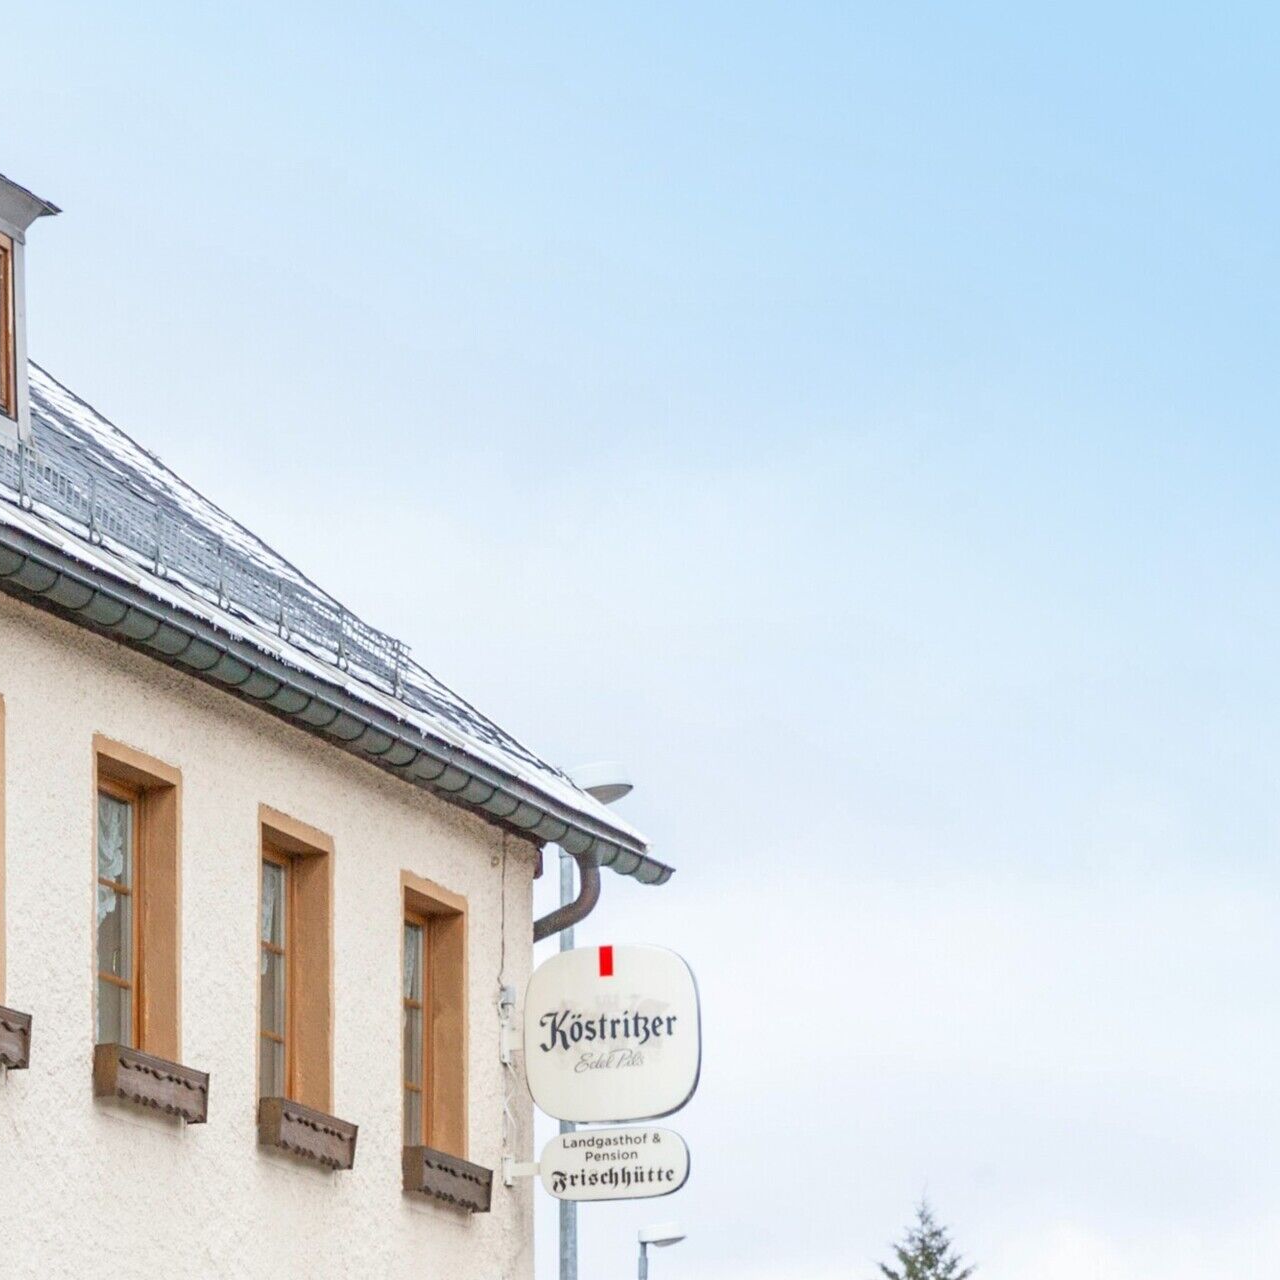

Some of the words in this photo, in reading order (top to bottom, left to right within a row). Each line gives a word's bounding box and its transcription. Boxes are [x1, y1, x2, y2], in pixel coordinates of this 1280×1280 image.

[539, 1010, 677, 1052] Köstritzer
[562, 1133, 648, 1150] Landgasthof
[652, 1133, 661, 1144] &
[585, 1150, 639, 1162] Pension
[552, 1166, 675, 1193] Frischhütte
